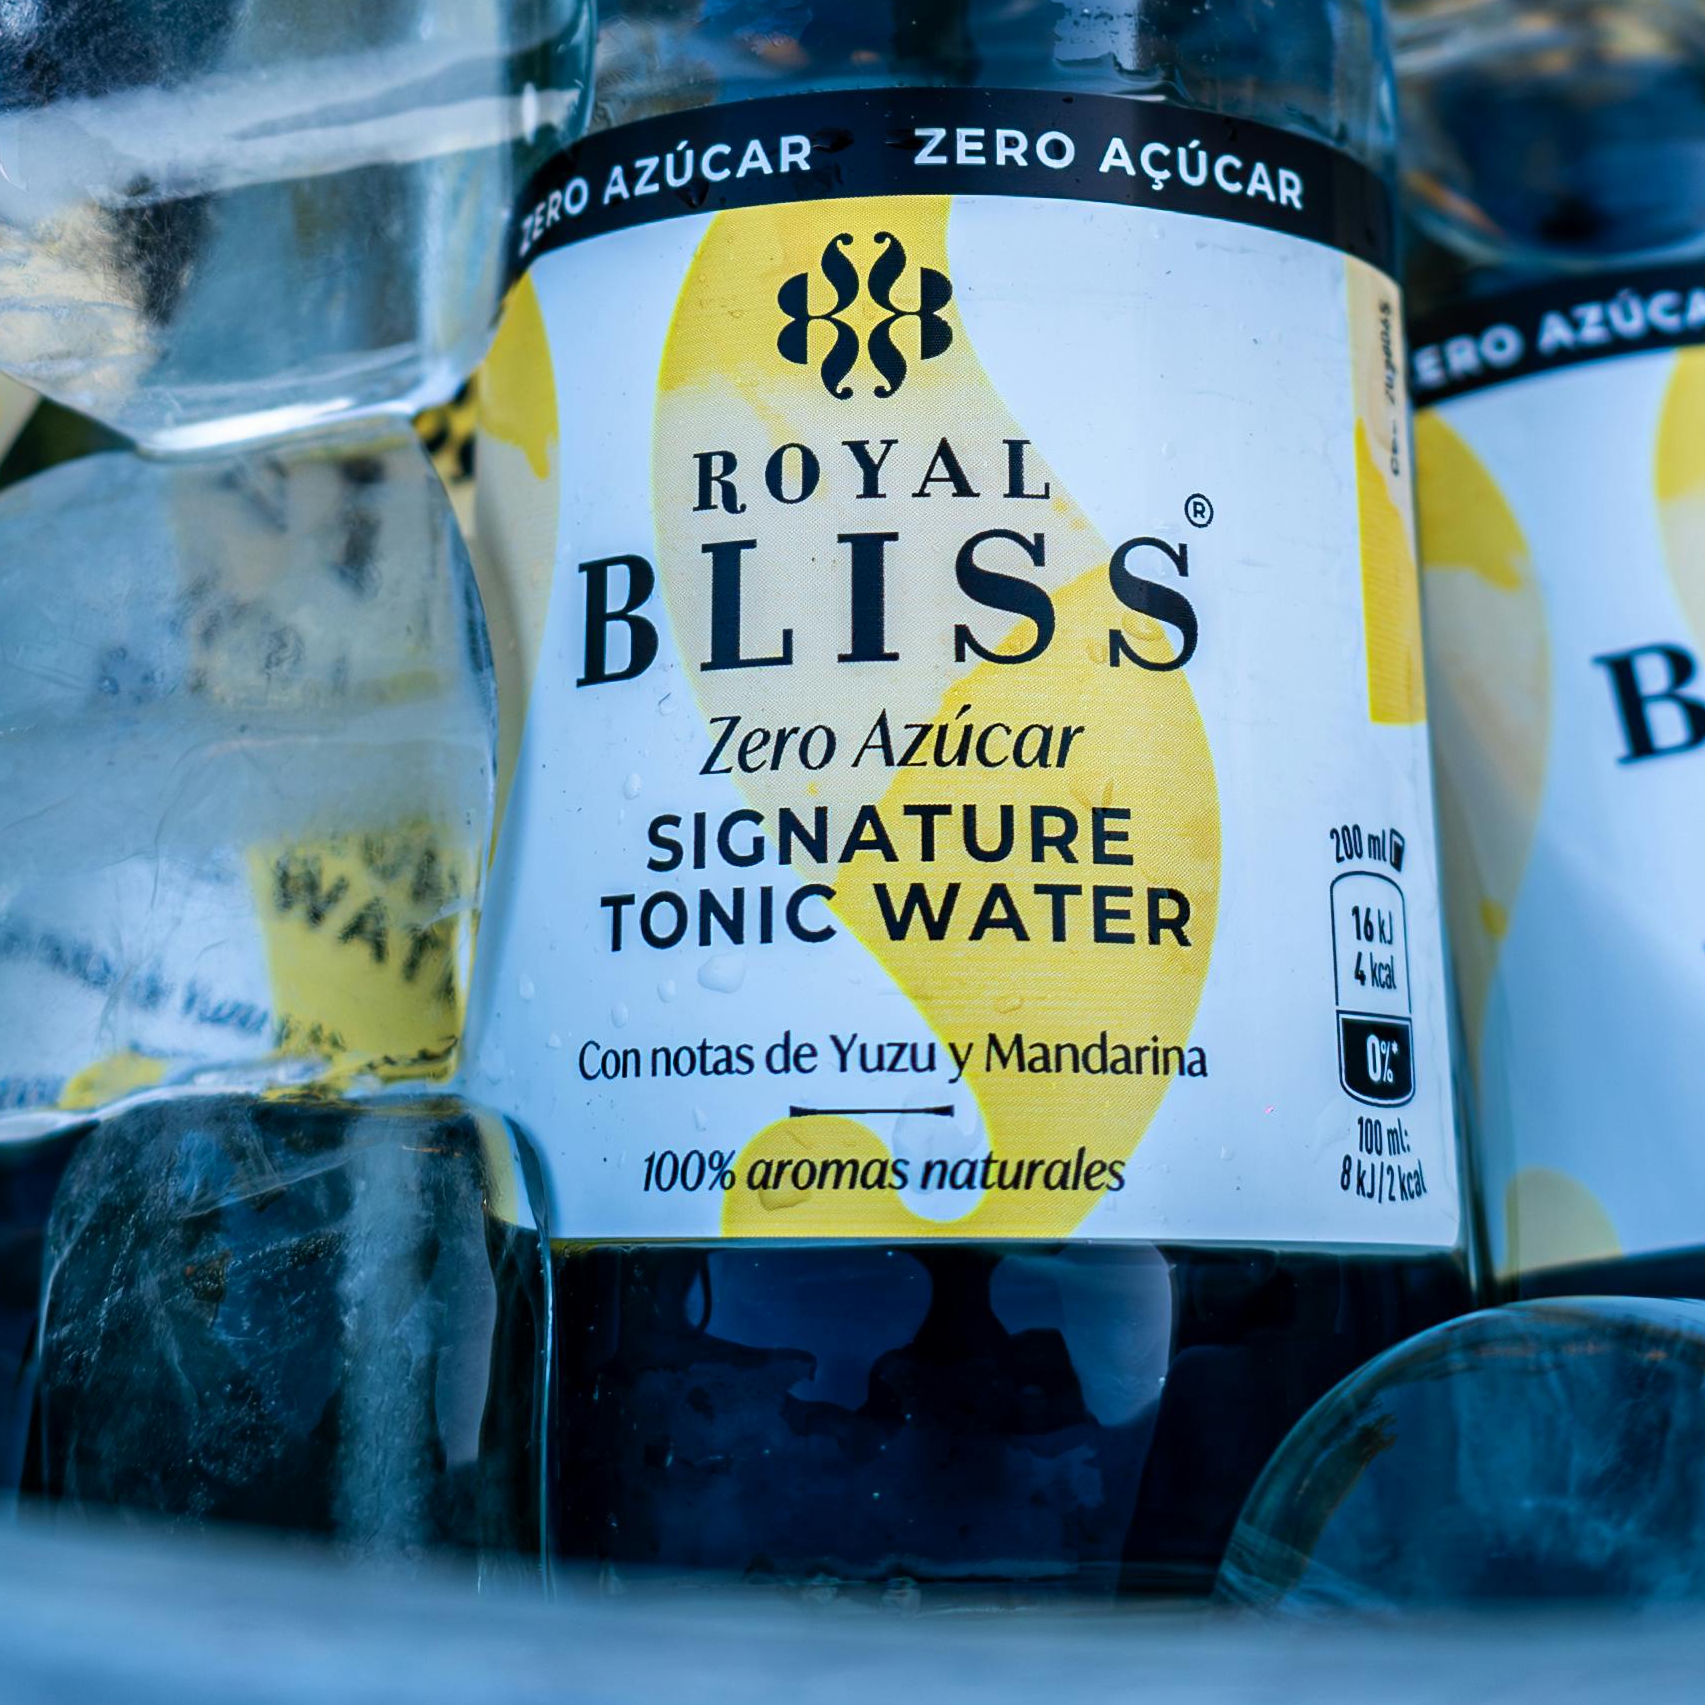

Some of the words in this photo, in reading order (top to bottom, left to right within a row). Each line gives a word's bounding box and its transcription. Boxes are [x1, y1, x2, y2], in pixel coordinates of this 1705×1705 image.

[518, 173, 589, 260] ZERO
[601, 132, 813, 208] AZÚCAR
[912, 125, 1077, 171] ZERO
[1097, 134, 1305, 211] AÇÚCAR
[1413, 323, 1525, 388] ERO
[691, 435, 1052, 517] ROYAL
[574, 526, 1200, 689] BLISS
[698, 712, 838, 778] Zero
[851, 703, 1085, 772] Azúcar
[645, 800, 1136, 874] SIGNATURE
[1329, 823, 1364, 865] 200
[1367, 828, 1389, 864] ml
[598, 880, 837, 955] TONIC
[873, 879, 1194, 950] WATER
[1351, 904, 1375, 944] 16
[1376, 908, 1395, 946] kJ
[1353, 951, 1368, 988] 4
[1369, 954, 1398, 992] kcal
[577, 1037, 643, 1082] Con
[647, 1037, 756, 1078] notas
[763, 1031, 818, 1076] de
[828, 1032, 939, 1074] Yuzu
[946, 1040, 974, 1084] y
[983, 1029, 1209, 1080] Mandarina
[1356, 1114, 1384, 1157] 100
[640, 1146, 737, 1195] 100%
[745, 1153, 910, 1193] aromas
[918, 1144, 1127, 1194] naturales
[1339, 1154, 1354, 1193] 8
[1398, 1157, 1429, 1203] kcal
